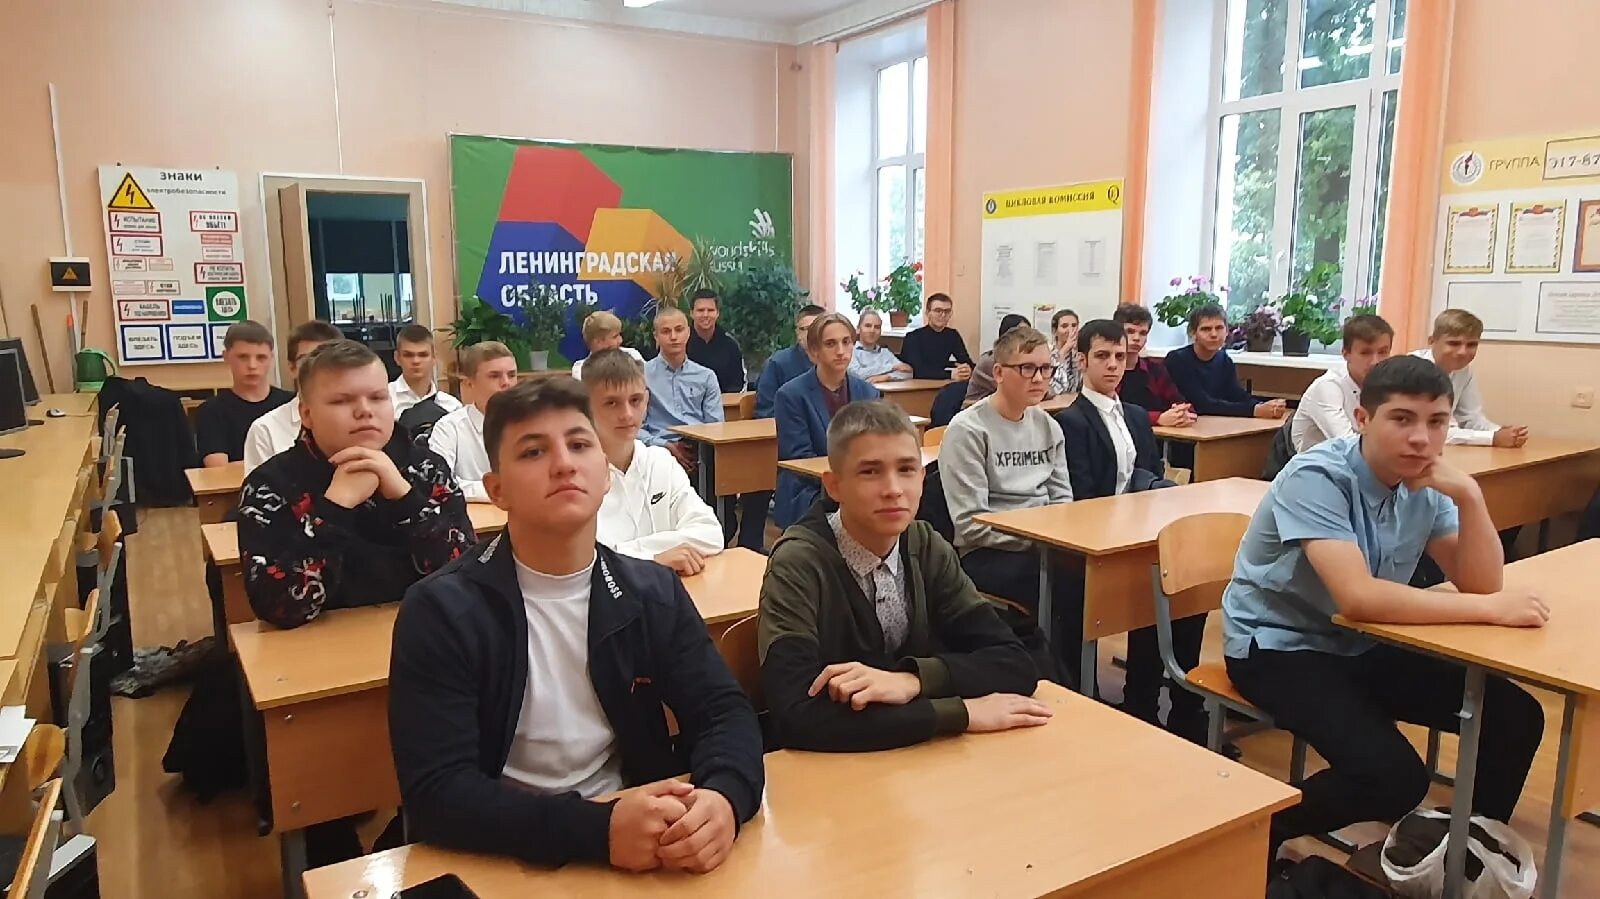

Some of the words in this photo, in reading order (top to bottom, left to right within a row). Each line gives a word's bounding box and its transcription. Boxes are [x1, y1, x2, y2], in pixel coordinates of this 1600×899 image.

[1489, 156, 1541, 171] ГРУППА
[499, 251, 677, 277] ЛЕНИНГРАДСКАЯ
[995, 445, 1053, 467] XPERIMENT
